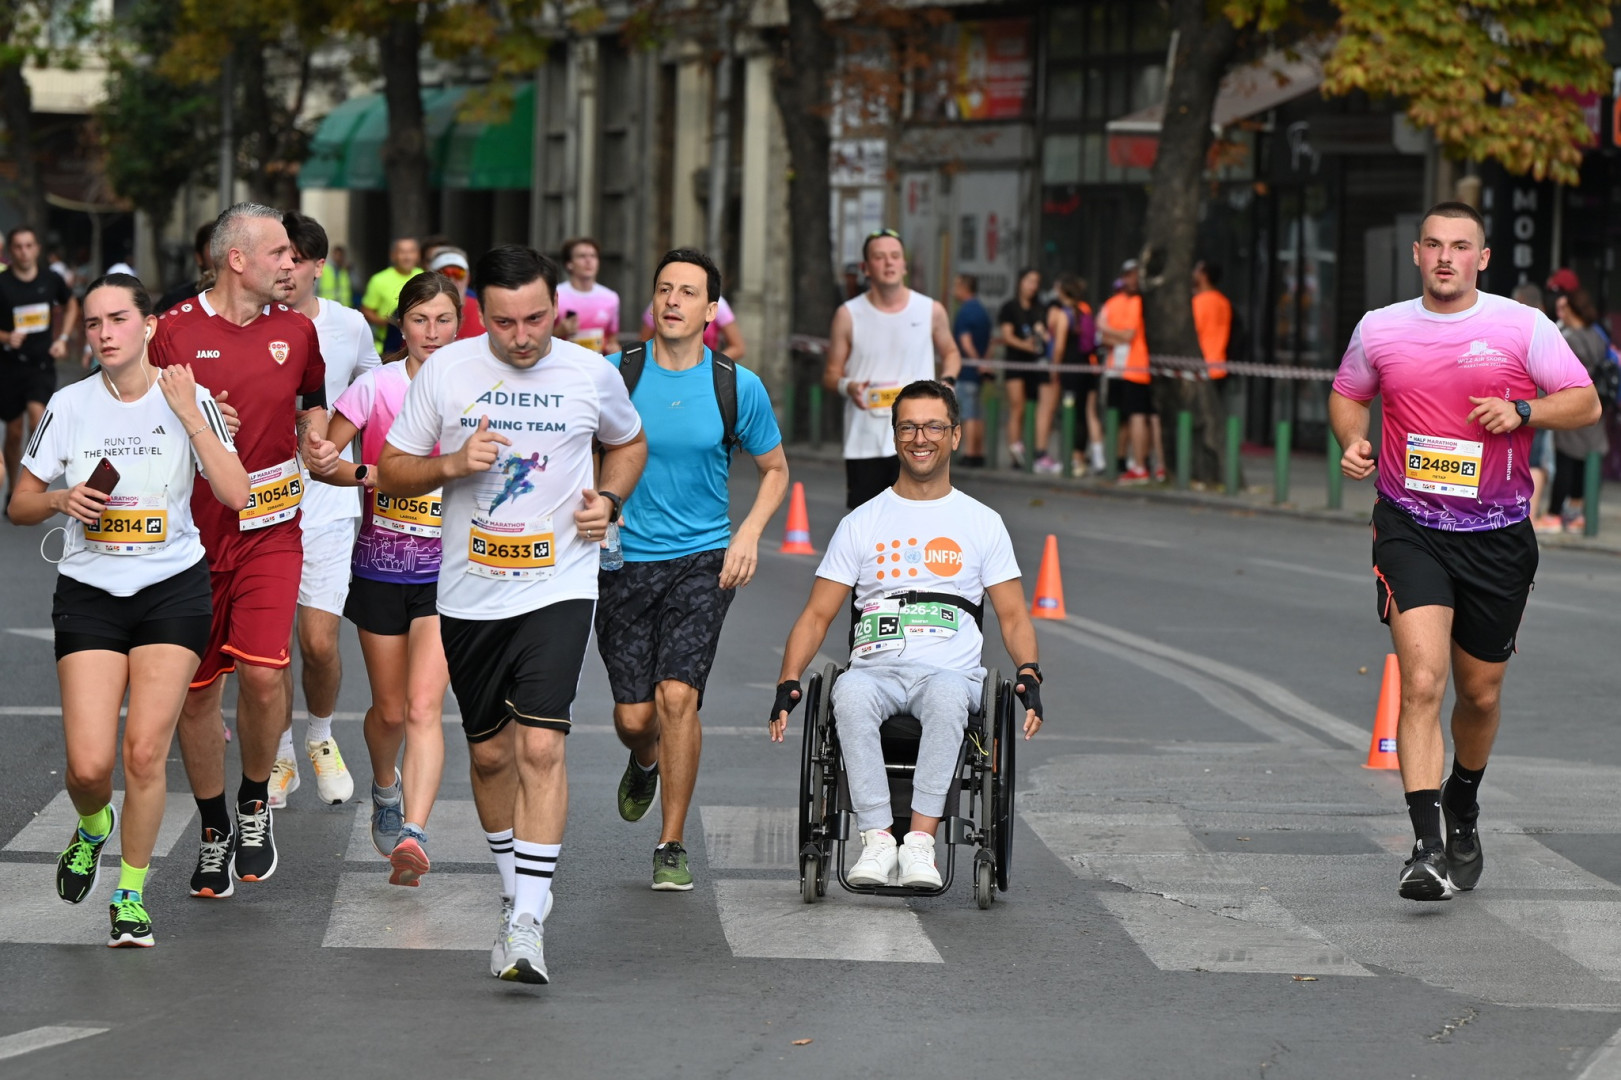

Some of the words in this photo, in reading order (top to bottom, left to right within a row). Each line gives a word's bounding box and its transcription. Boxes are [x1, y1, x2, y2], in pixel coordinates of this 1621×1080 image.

[195, 350, 221, 359] JAKO
[1457, 356, 1473, 364] WIZZ
[475, 391, 565, 408] ADIENT
[527, 421, 566, 432] TEAM
[104, 438, 125, 446] RUN
[127, 436, 142, 446] TO
[1427, 439, 1458, 447] MARATHON
[84, 449, 102, 459] THE
[104, 447, 131, 456] NEXT
[133, 446, 163, 456] LEVEL
[1421, 457, 1461, 473] 2489
[257, 467, 283, 479] MARATHON
[257, 484, 289, 505] 1054
[393, 498, 428, 514] 1056
[103, 518, 143, 533] 2814
[477, 517, 489, 525] HALF
[490, 520, 525, 528] MARATHON
[488, 543, 531, 558] 2633
[923, 549, 964, 566] UNFPA
